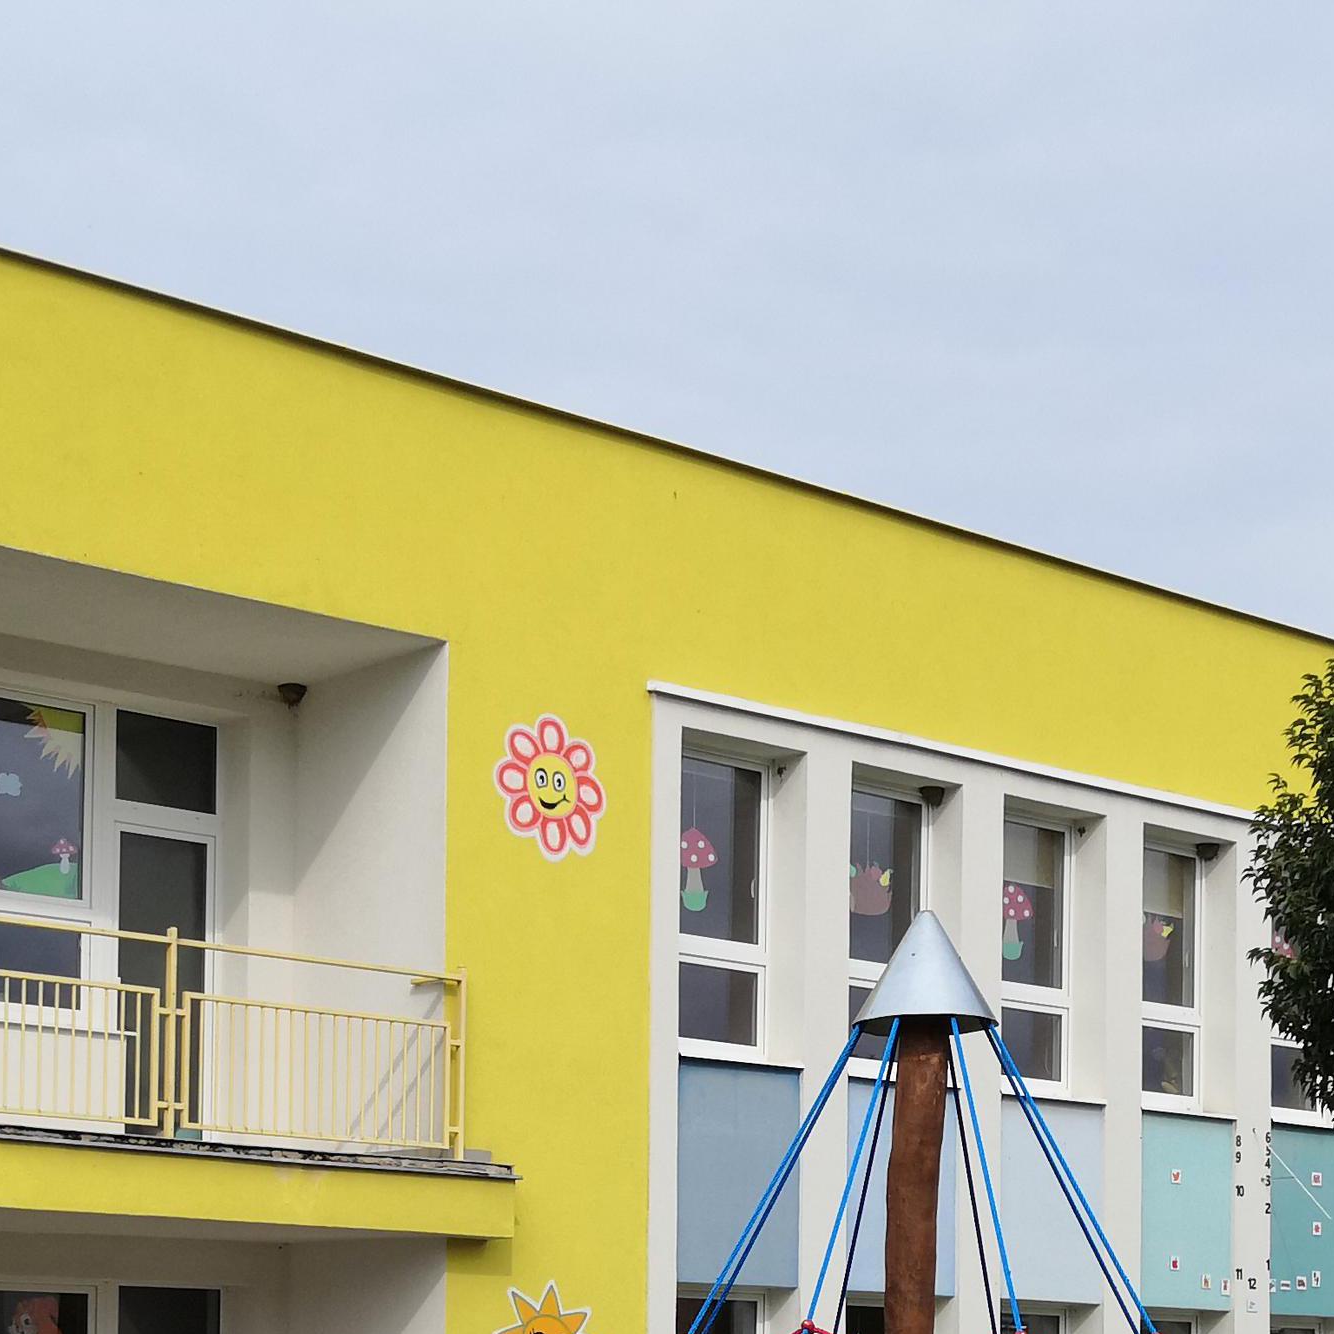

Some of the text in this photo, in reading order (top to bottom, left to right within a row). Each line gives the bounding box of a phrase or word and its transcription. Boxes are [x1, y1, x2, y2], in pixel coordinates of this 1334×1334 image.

[1235, 1135, 1242, 1147] 8
[1265, 1132, 1271, 1144] 6
[1235, 1151, 1242, 1163] 9
[1265, 1158, 1271, 1169] 4
[1265, 1175, 1271, 1187] 3
[1235, 1185, 1245, 1197] 10
[1265, 1202, 1271, 1214] 2
[1235, 1268, 1243, 1280] 11
[1247, 1278, 1257, 1290] 12
